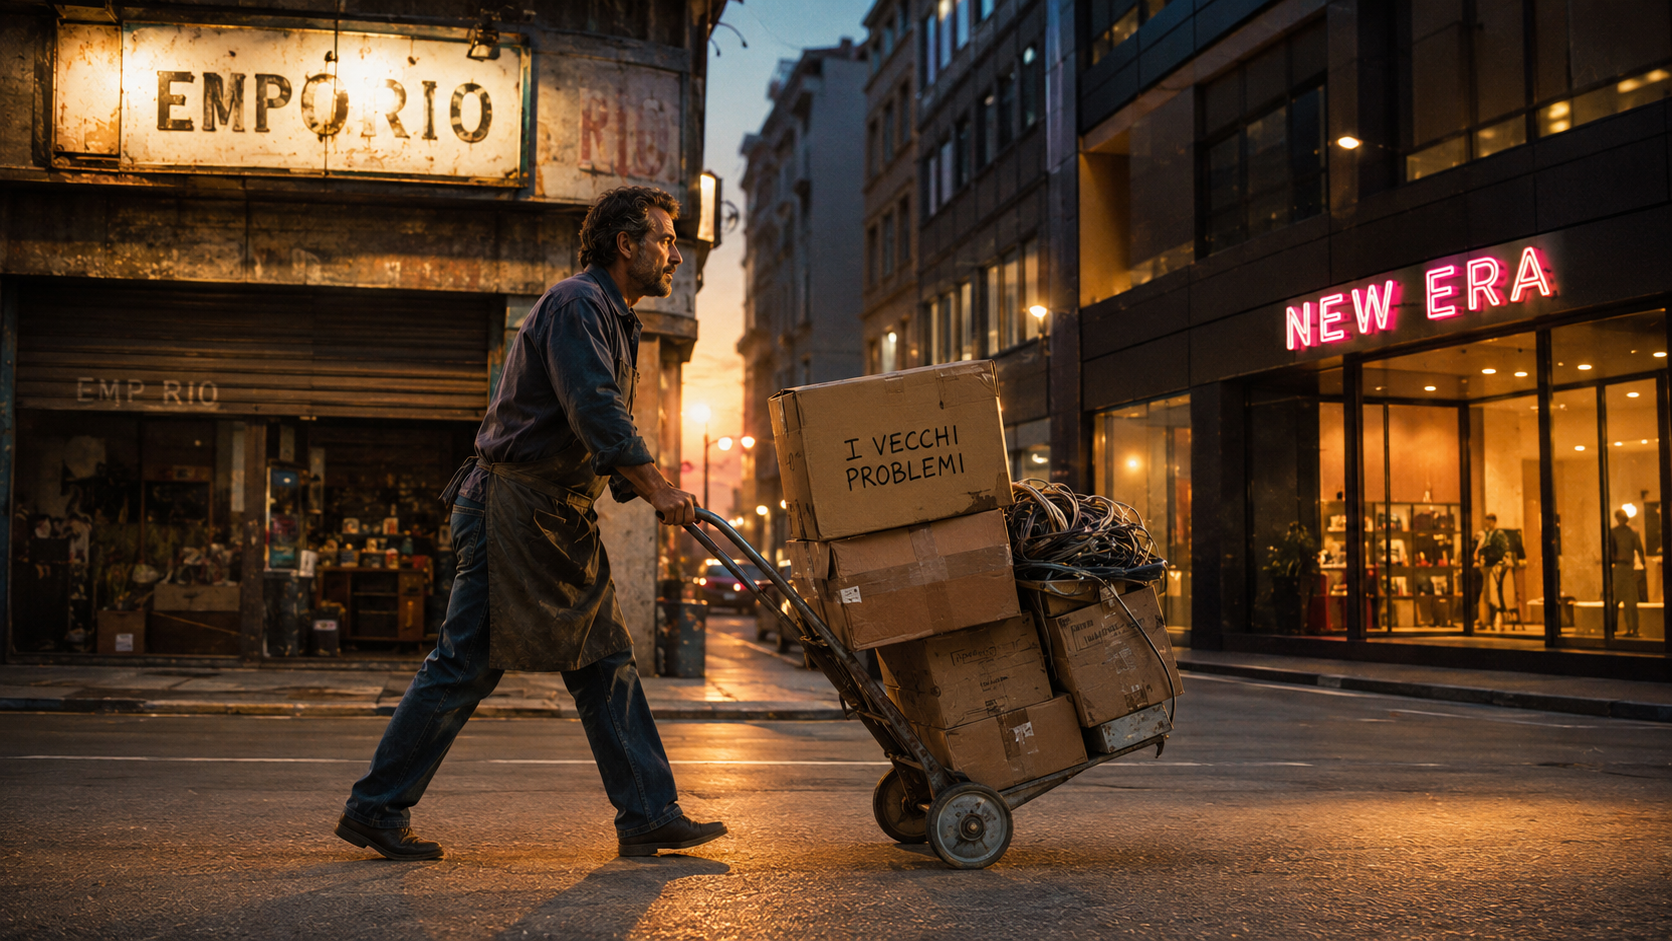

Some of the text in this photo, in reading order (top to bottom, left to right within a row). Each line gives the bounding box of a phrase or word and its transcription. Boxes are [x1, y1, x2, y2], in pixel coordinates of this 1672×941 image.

[156, 70, 494, 144] EMPORIO
[1285, 246, 1551, 351] NEW ERA
[843, 424, 959, 462] I VECCHI
[845, 452, 965, 492] PROBLEMI
